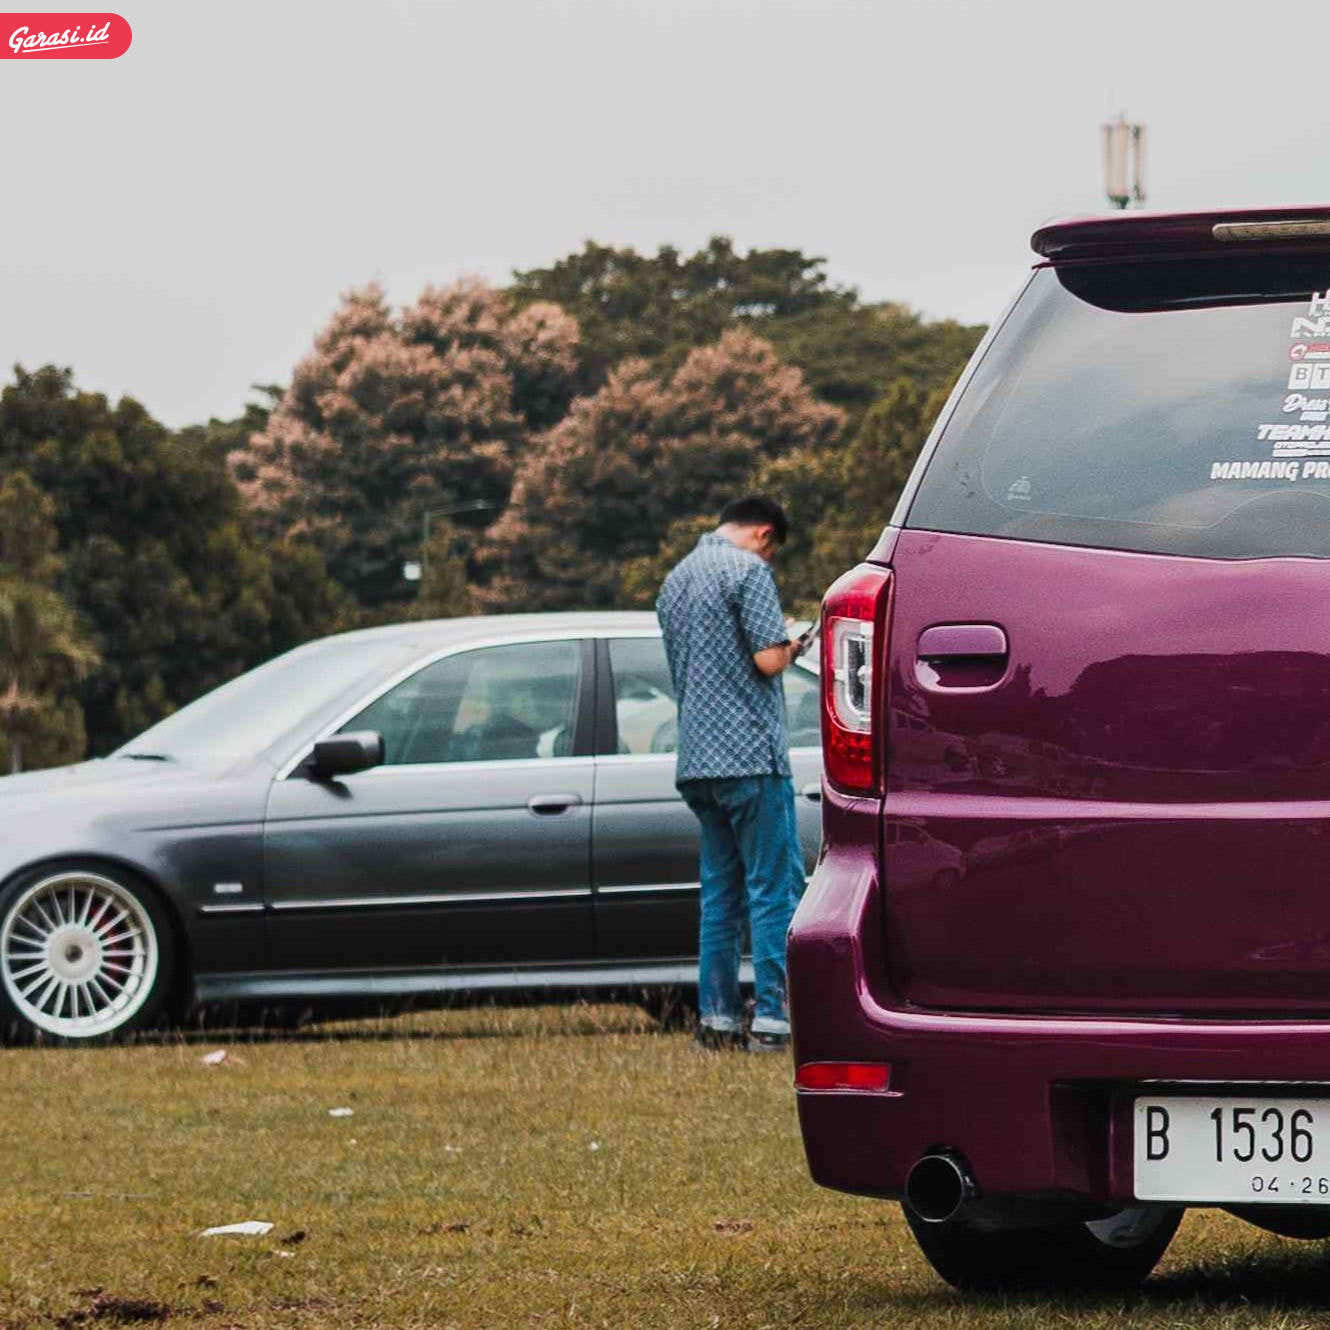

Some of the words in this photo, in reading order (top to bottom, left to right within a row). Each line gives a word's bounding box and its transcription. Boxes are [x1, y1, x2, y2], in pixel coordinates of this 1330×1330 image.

[1210, 461, 1299, 481] MAMANG
[1146, 1105, 1170, 1161] B
[1210, 1107, 1314, 1163] 1536
